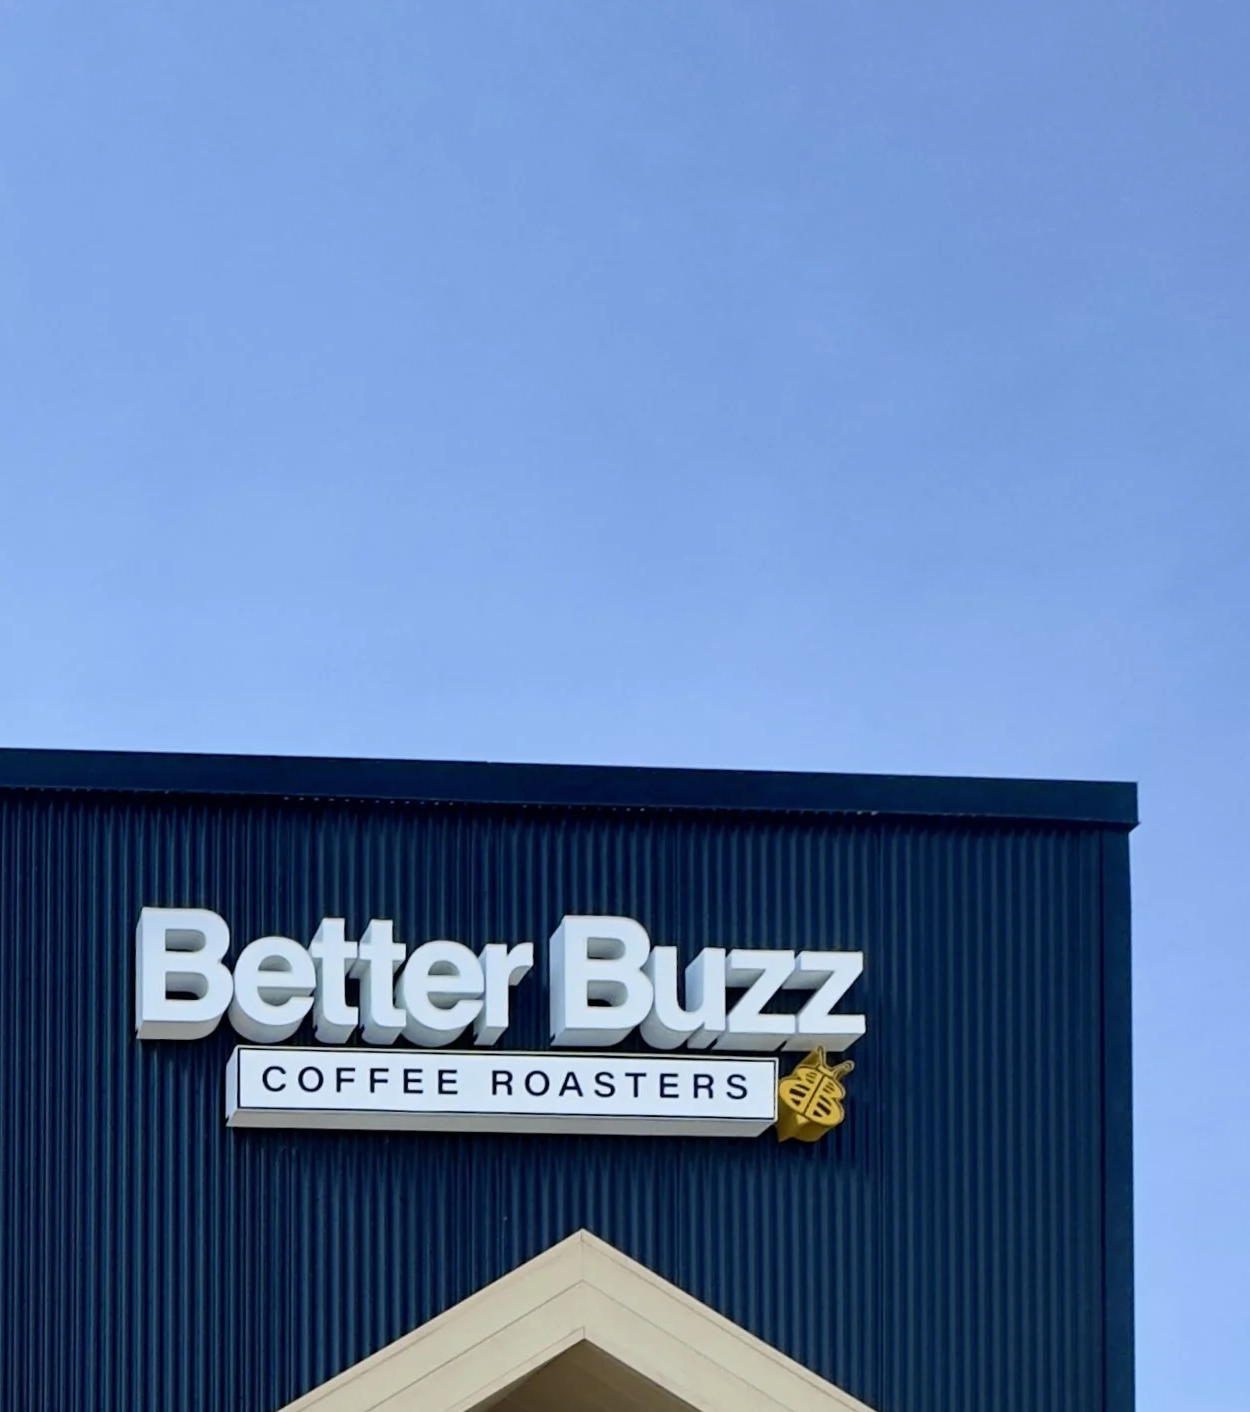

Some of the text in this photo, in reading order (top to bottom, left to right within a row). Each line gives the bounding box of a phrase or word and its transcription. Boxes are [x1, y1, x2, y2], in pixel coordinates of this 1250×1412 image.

[137, 906, 866, 1047] Better Buzz
[260, 1065, 751, 1100] COFFEE ROASTERS
